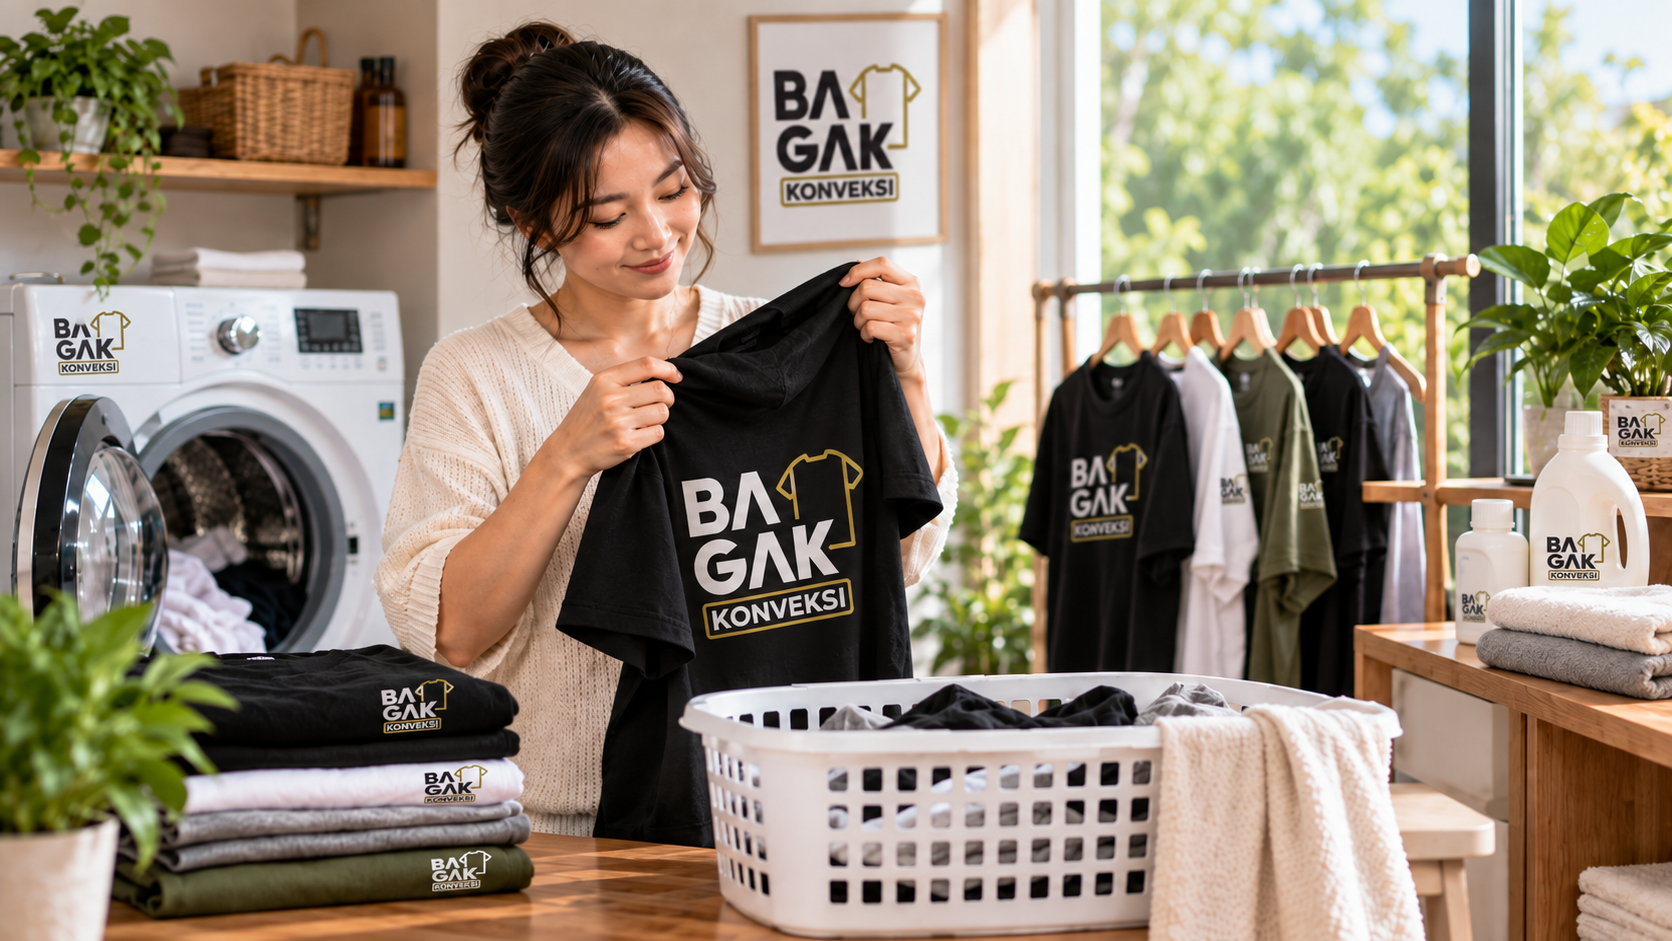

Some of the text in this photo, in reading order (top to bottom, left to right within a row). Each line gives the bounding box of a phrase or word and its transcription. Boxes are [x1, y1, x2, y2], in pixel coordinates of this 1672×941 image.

[773, 70, 850, 121] BA
[776, 122, 894, 173] GAK
[786, 178, 894, 202] KONVEKSI
[53, 317, 91, 338] BA
[56, 338, 115, 361] GAK
[61, 362, 116, 373] KONVEKSI
[1617, 416, 1641, 428] BA
[1618, 428, 1655, 439] GAK
[1071, 455, 1108, 488] BA
[681, 470, 781, 538] BA
[1070, 483, 1129, 518] GAK
[1073, 520, 1131, 537] KONVEKSI
[1546, 536, 1578, 553] BA
[693, 519, 840, 596] GAK
[1547, 553, 1596, 569] GAK
[1461, 593, 1475, 604] BA
[711, 587, 846, 631] KONVEKSI
[380, 687, 416, 706] BA
[382, 700, 438, 721] GAK
[386, 719, 439, 732] KONVEKSI
[424, 771, 455, 784] BA
[425, 781, 473, 795] GAK
[431, 856, 460, 871] BA
[431, 867, 477, 882] GAK
